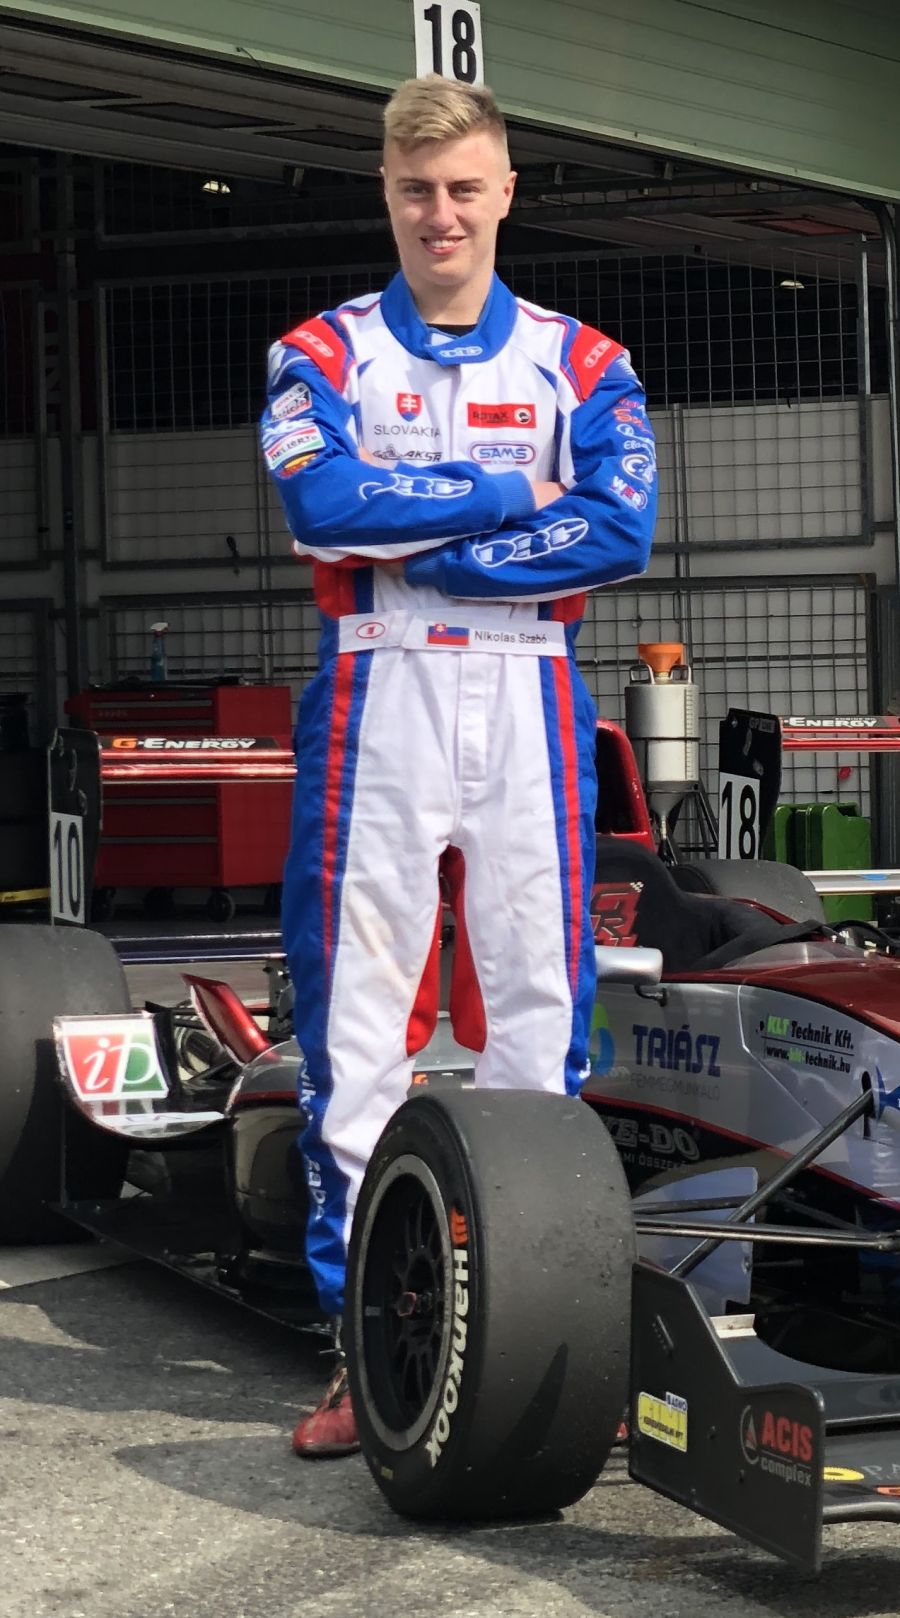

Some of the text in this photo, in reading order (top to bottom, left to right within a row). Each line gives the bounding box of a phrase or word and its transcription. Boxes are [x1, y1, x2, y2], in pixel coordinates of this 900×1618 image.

[424, 4, 476, 84] 18
[374, 424, 441, 438] SLOVAKIA
[479, 447, 527, 459] SAMS
[474, 630, 547, 645] Nikolas Szabó
[784, 717, 877, 728] -ENERGY
[721, 781, 756, 860] 18
[54, 820, 80, 918] 10
[791, 1020, 831, 1045] Technik
[835, 1029, 854, 1050] Kft.
[633, 1024, 720, 1077] TRIÁSZ
[762, 1411, 813, 1462] ACIS
[761, 1459, 812, 1487] complex
